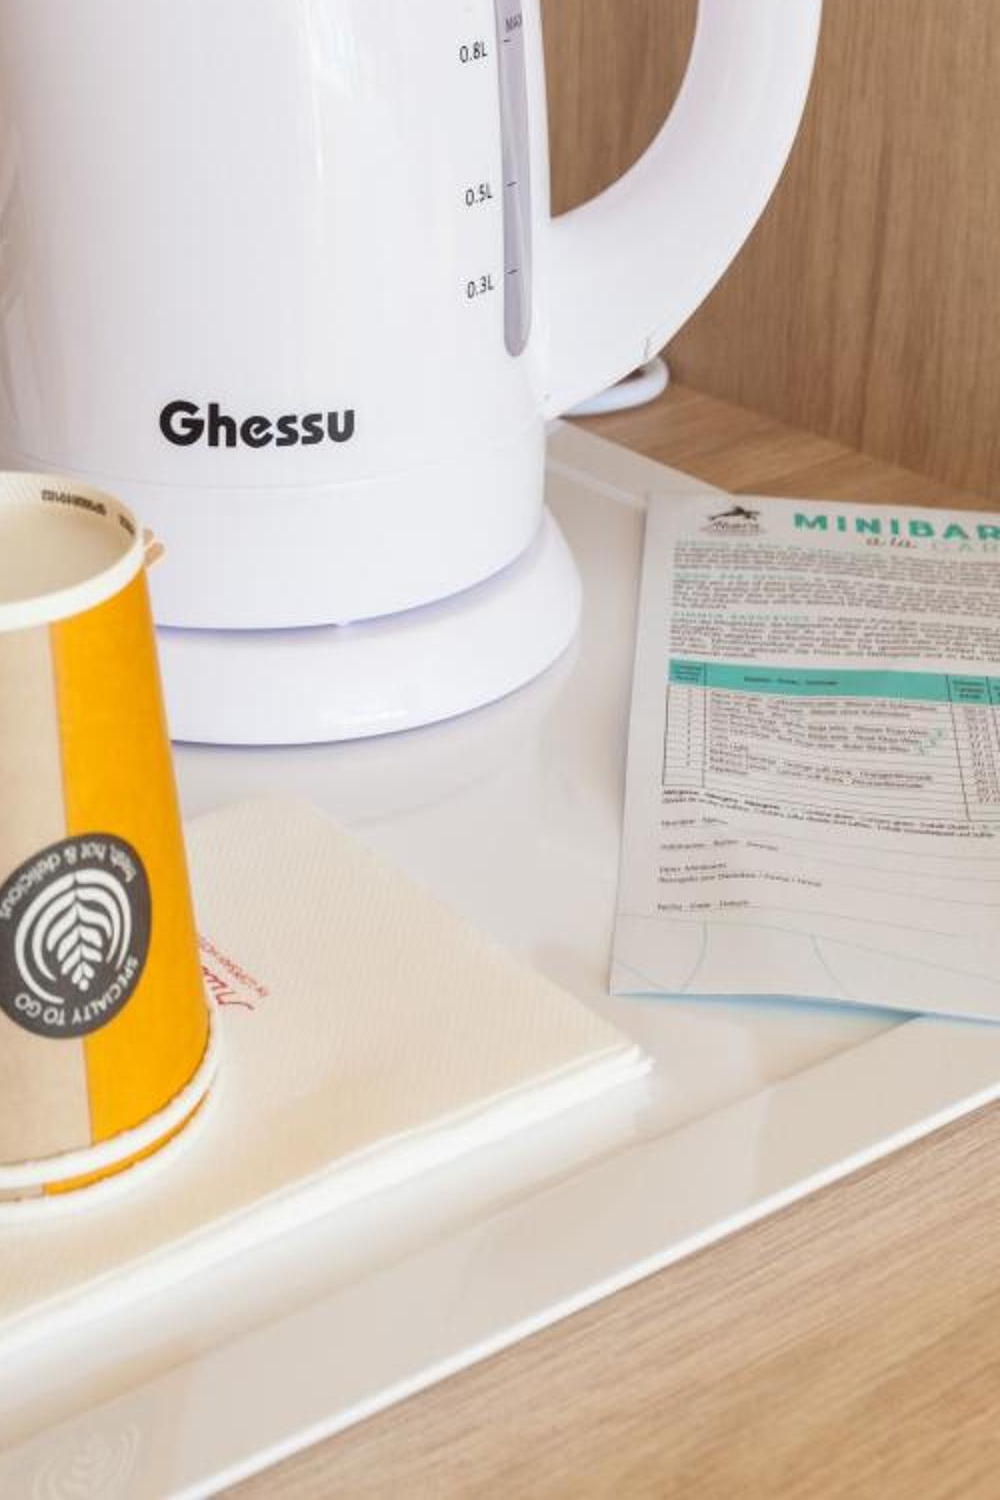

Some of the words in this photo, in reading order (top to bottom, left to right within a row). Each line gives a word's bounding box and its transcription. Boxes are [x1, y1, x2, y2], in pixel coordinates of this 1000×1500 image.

[459, 41, 488, 63] 0.8L
[465, 182, 493, 206] 0.5L
[467, 274, 494, 299] 0.3L
[159, 399, 355, 449] Ghessu
[794, 512, 1000, 542] MINIBAR
[79, 842, 107, 861] hot
[71, 954, 140, 1026] SPECIALTY
[14, 992, 43, 1018] GO
[43, 1003, 66, 1026] TO
